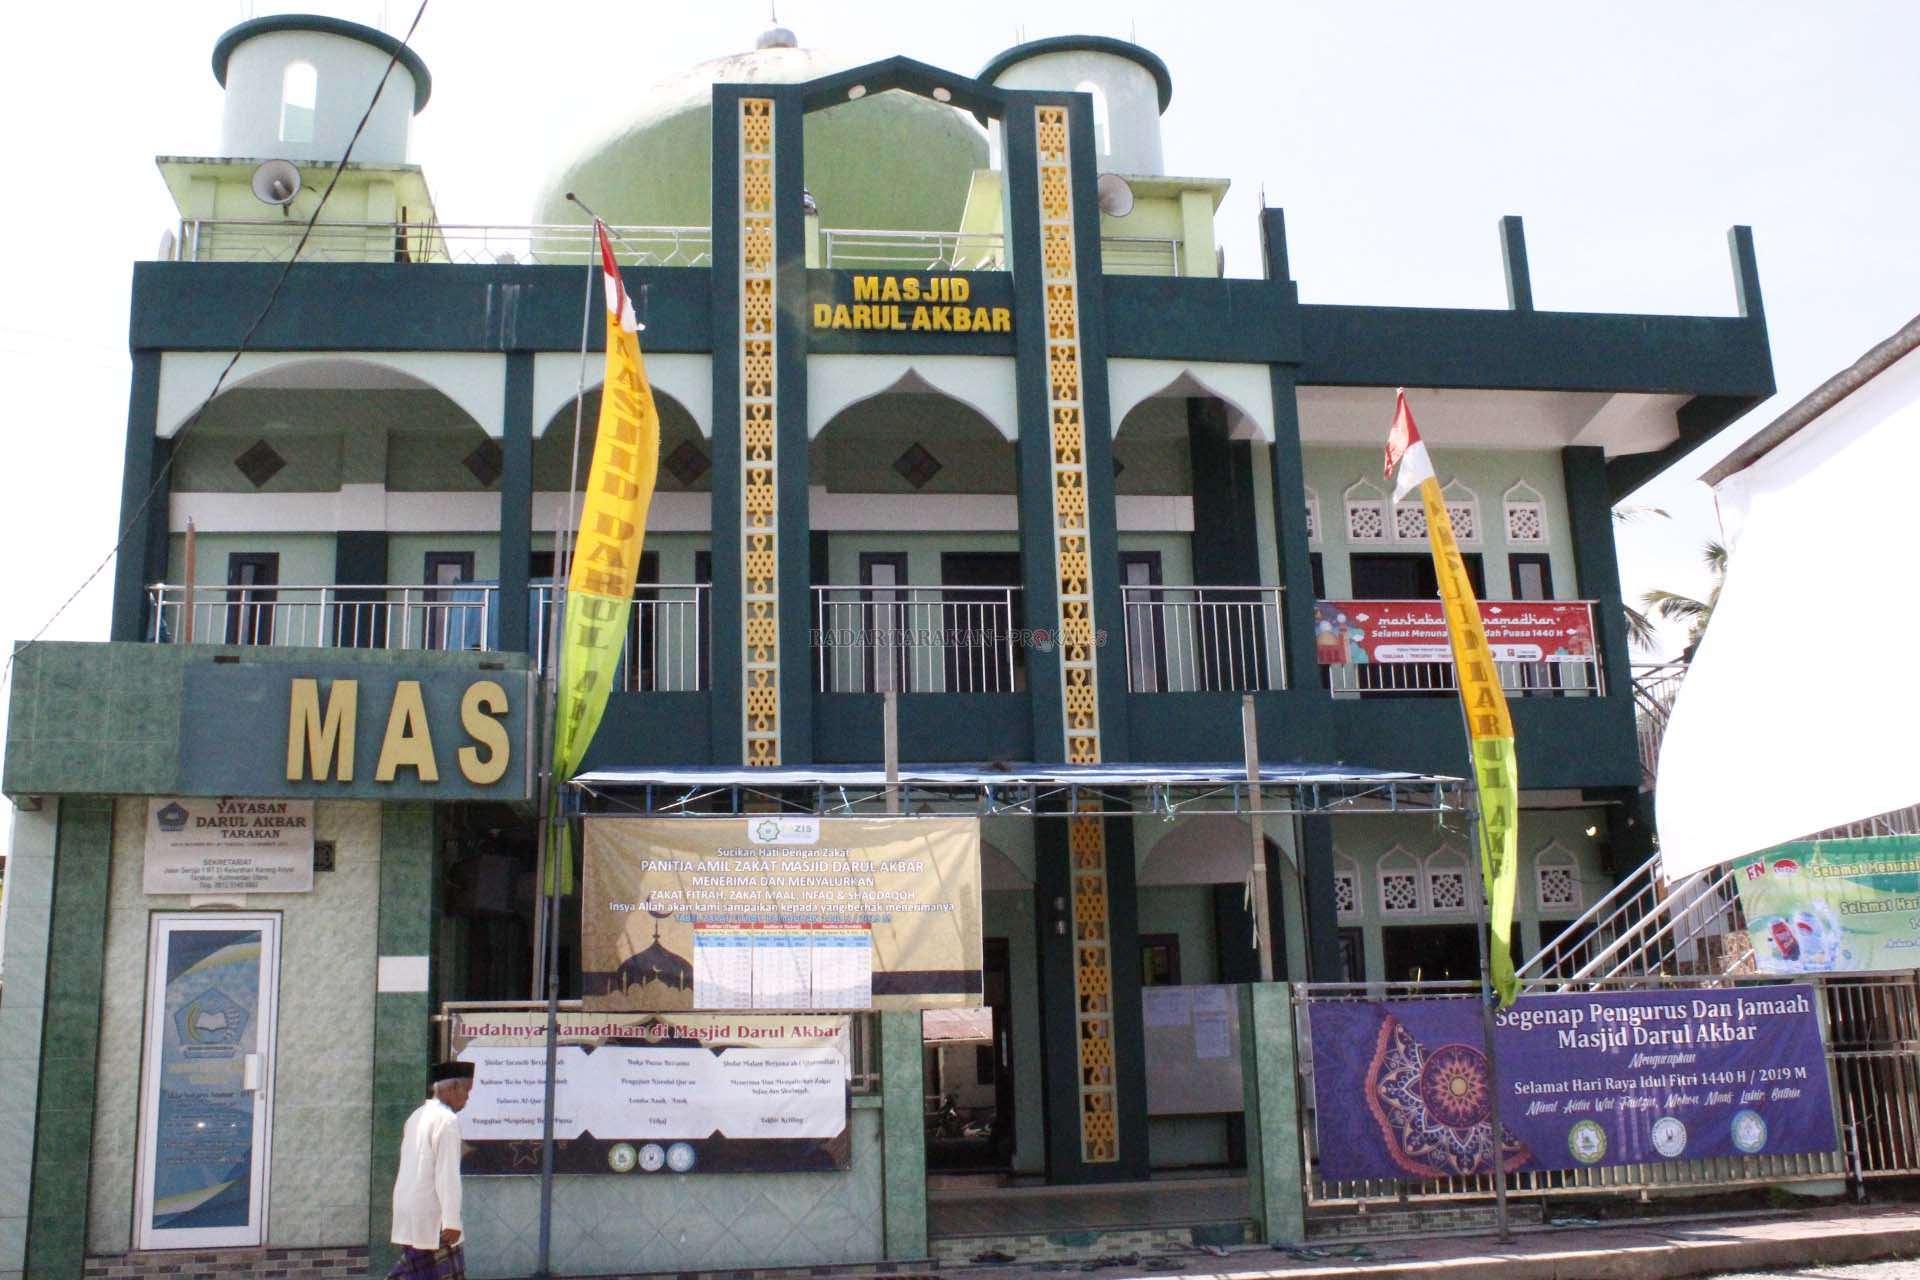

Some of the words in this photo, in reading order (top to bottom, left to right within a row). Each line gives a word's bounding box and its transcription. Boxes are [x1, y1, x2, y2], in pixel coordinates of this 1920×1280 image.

[853, 276, 970, 302] MASJID
[813, 304, 906, 330] DARUL
[912, 306, 1011, 333] AKBAR
[1372, 629, 1410, 638] Selamat
[1503, 629, 1531, 638] Puasa
[1533, 629, 1554, 637] 1440
[1556, 629, 1564, 637] H
[286, 678, 511, 784] MAS
[216, 802, 288, 814] YAYASAN
[196, 816, 249, 828] DARUL
[253, 816, 307, 828] AKBAR
[221, 829, 281, 839] TARAKAN
[717, 848, 756, 858] Sucikan
[759, 848, 779, 857] Hati
[782, 848, 820, 859] Dengan
[822, 848, 850, 858] Zakat
[641, 860, 693, 872] PANITIA
[697, 860, 730, 872] AMIL
[735, 860, 777, 872] ZAKAT
[781, 861, 829, 873] MASJID
[832, 861, 876, 873] DARUL
[880, 861, 925, 873] AKBAR
[1813, 862, 1864, 877] Selamat
[692, 876, 757, 887] MENERIMA
[760, 877, 785, 887] DAN
[788, 877, 875, 887] MENYALURKAN
[650, 891, 683, 900] ZAKAT
[730, 891, 763, 900] ZAKAT
[609, 903, 636, 912] Insya
[639, 902, 665, 911] Allah
[695, 903, 720, 911] kami
[723, 903, 778, 912] sampaikan
[781, 903, 817, 913] kepada
[821, 904, 845, 913] yang
[847, 903, 882, 912] berhak
[886, 903, 954, 913] menerimanya
[1840, 898, 1894, 915] Selamat
[1496, 1006, 1584, 1031] Segenap
[1589, 1003, 1687, 1027] Pengurus
[1693, 999, 1733, 1019] Dan
[1737, 994, 1810, 1020] Jamaah
[460, 1023, 543, 1039] Indahnya
[556, 1023, 645, 1037] amadhan
[652, 1023, 669, 1037] di
[675, 1024, 731, 1041] Masjid
[737, 1025, 784, 1038] Darul
[791, 1025, 842, 1038] Akbar
[1558, 1028, 1628, 1052] Masjid
[1634, 1023, 1692, 1046] Darul
[1696, 1022, 1758, 1043] Akbar
[1514, 1079, 1568, 1095] Selamat
[1572, 1077, 1602, 1092] Hari
[1605, 1076, 1637, 1092] Raya
[1640, 1075, 1666, 1089] Idul
[1669, 1073, 1698, 1087] Fitri
[1702, 1071, 1734, 1085] 1440
[1737, 1070, 1746, 1083] H
[1750, 1069, 1756, 1085] /
[1759, 1068, 1792, 1082] 2019
[1794, 1066, 1808, 1080] M
[1594, 1097, 1615, 1112] Wal
